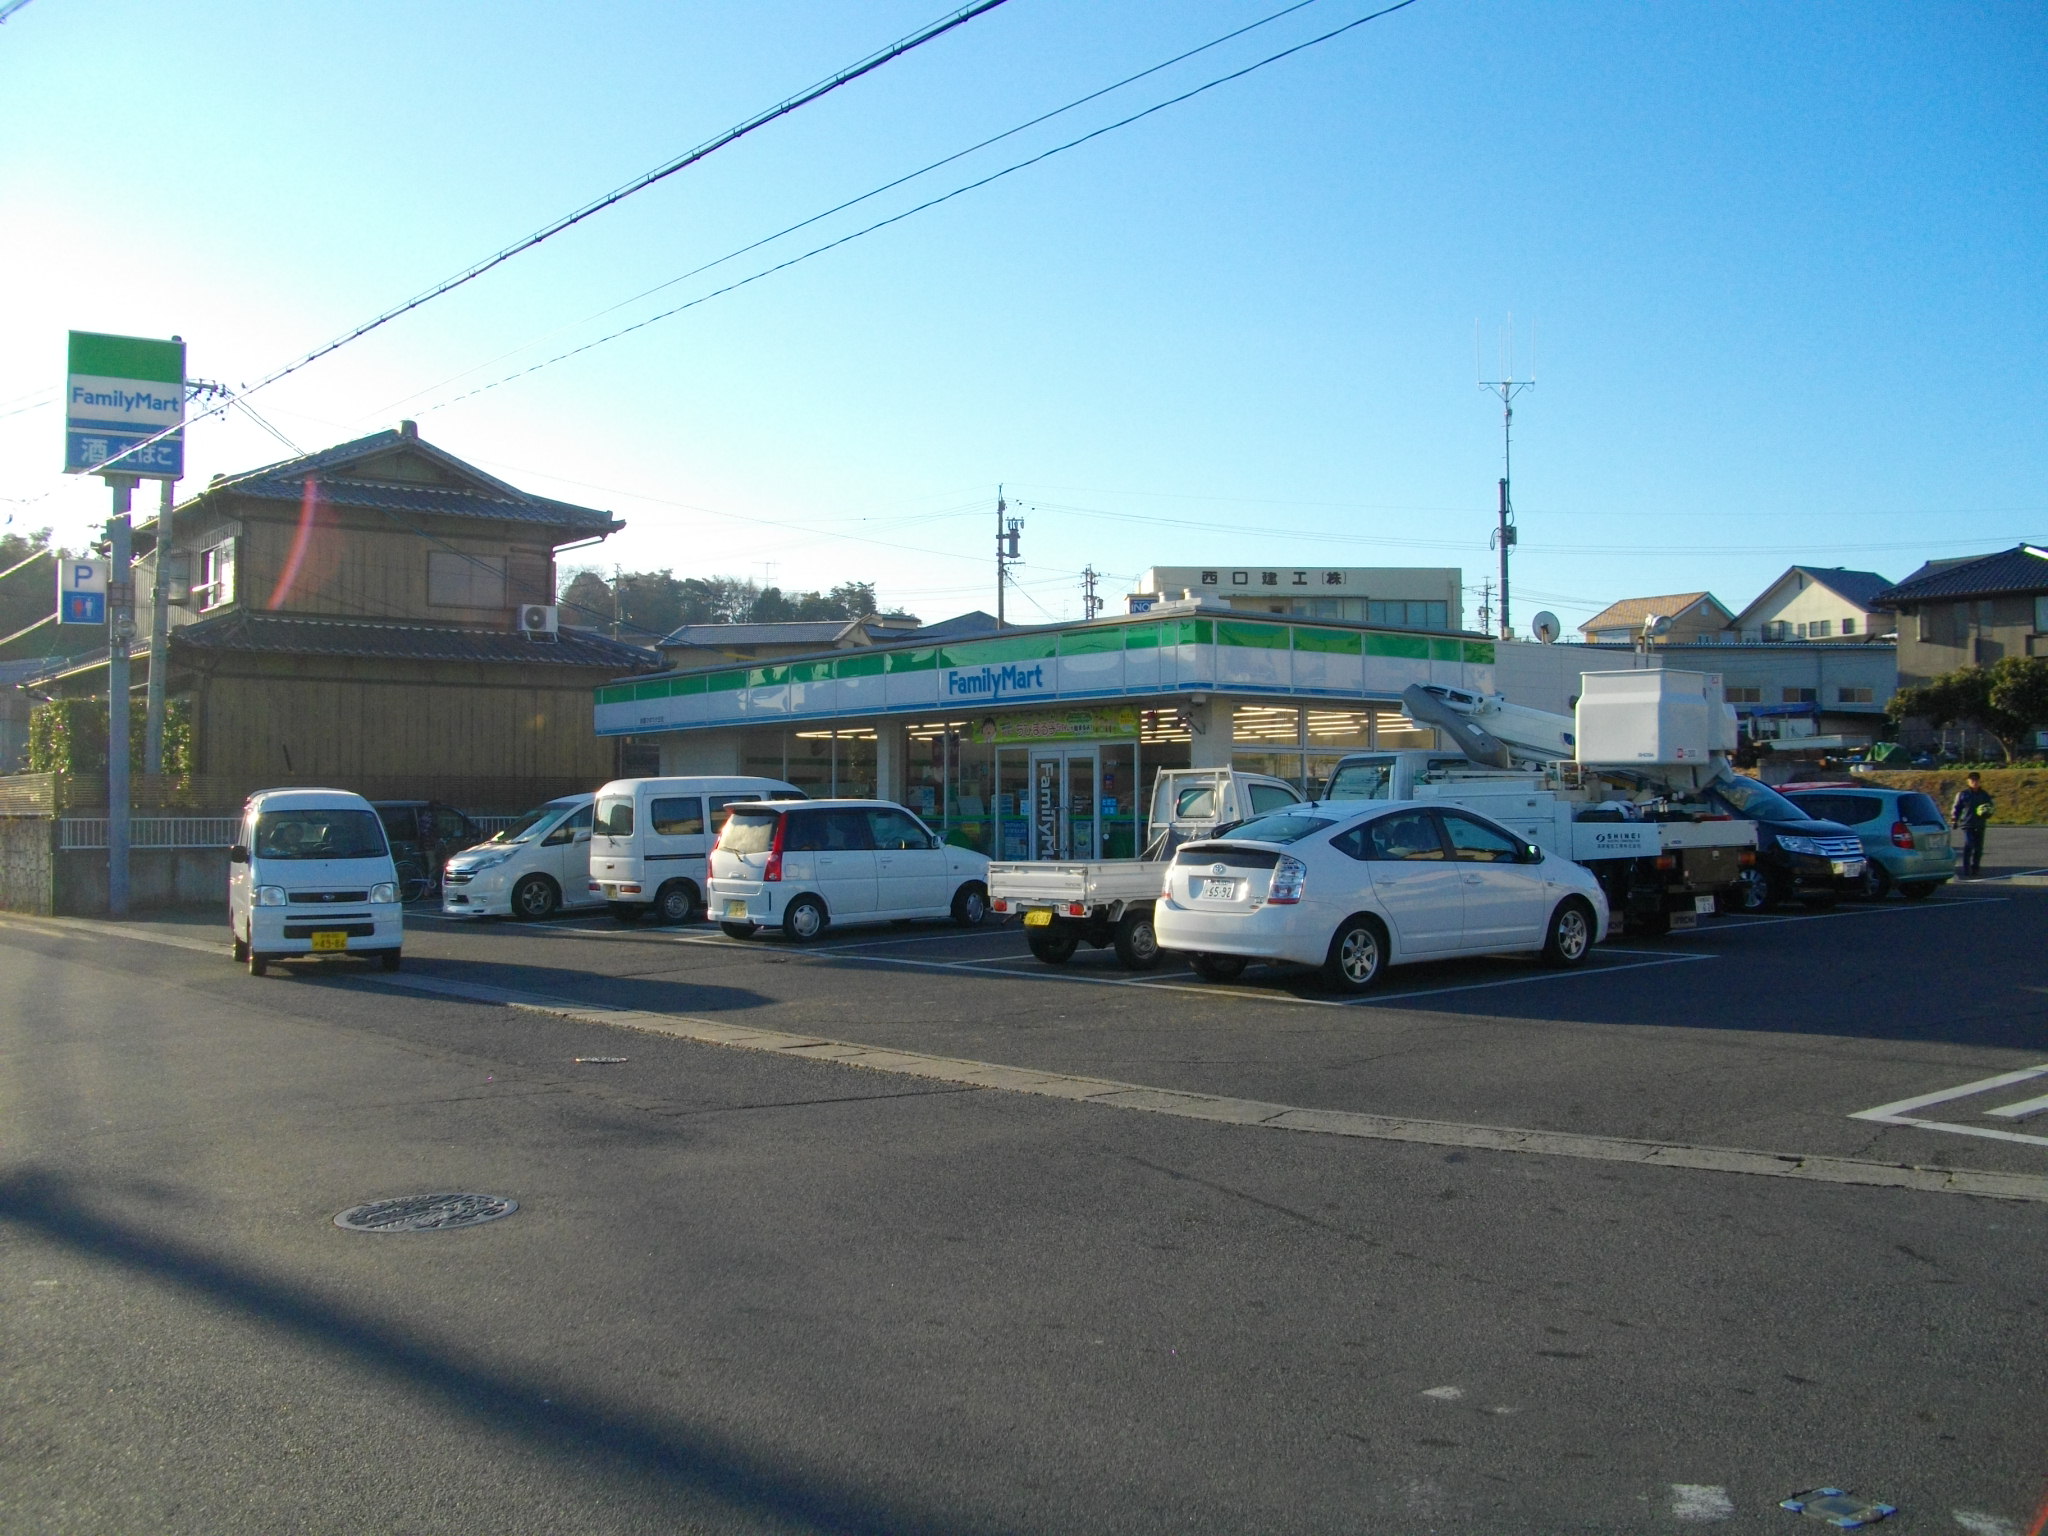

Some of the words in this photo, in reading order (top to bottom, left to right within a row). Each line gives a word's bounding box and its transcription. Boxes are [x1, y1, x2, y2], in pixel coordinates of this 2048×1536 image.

[72, 387, 180, 412] FamilyMart
[81, 438, 109, 463] 酒
[74, 565, 94, 588] P
[948, 661, 1044, 700] FamilyMart
